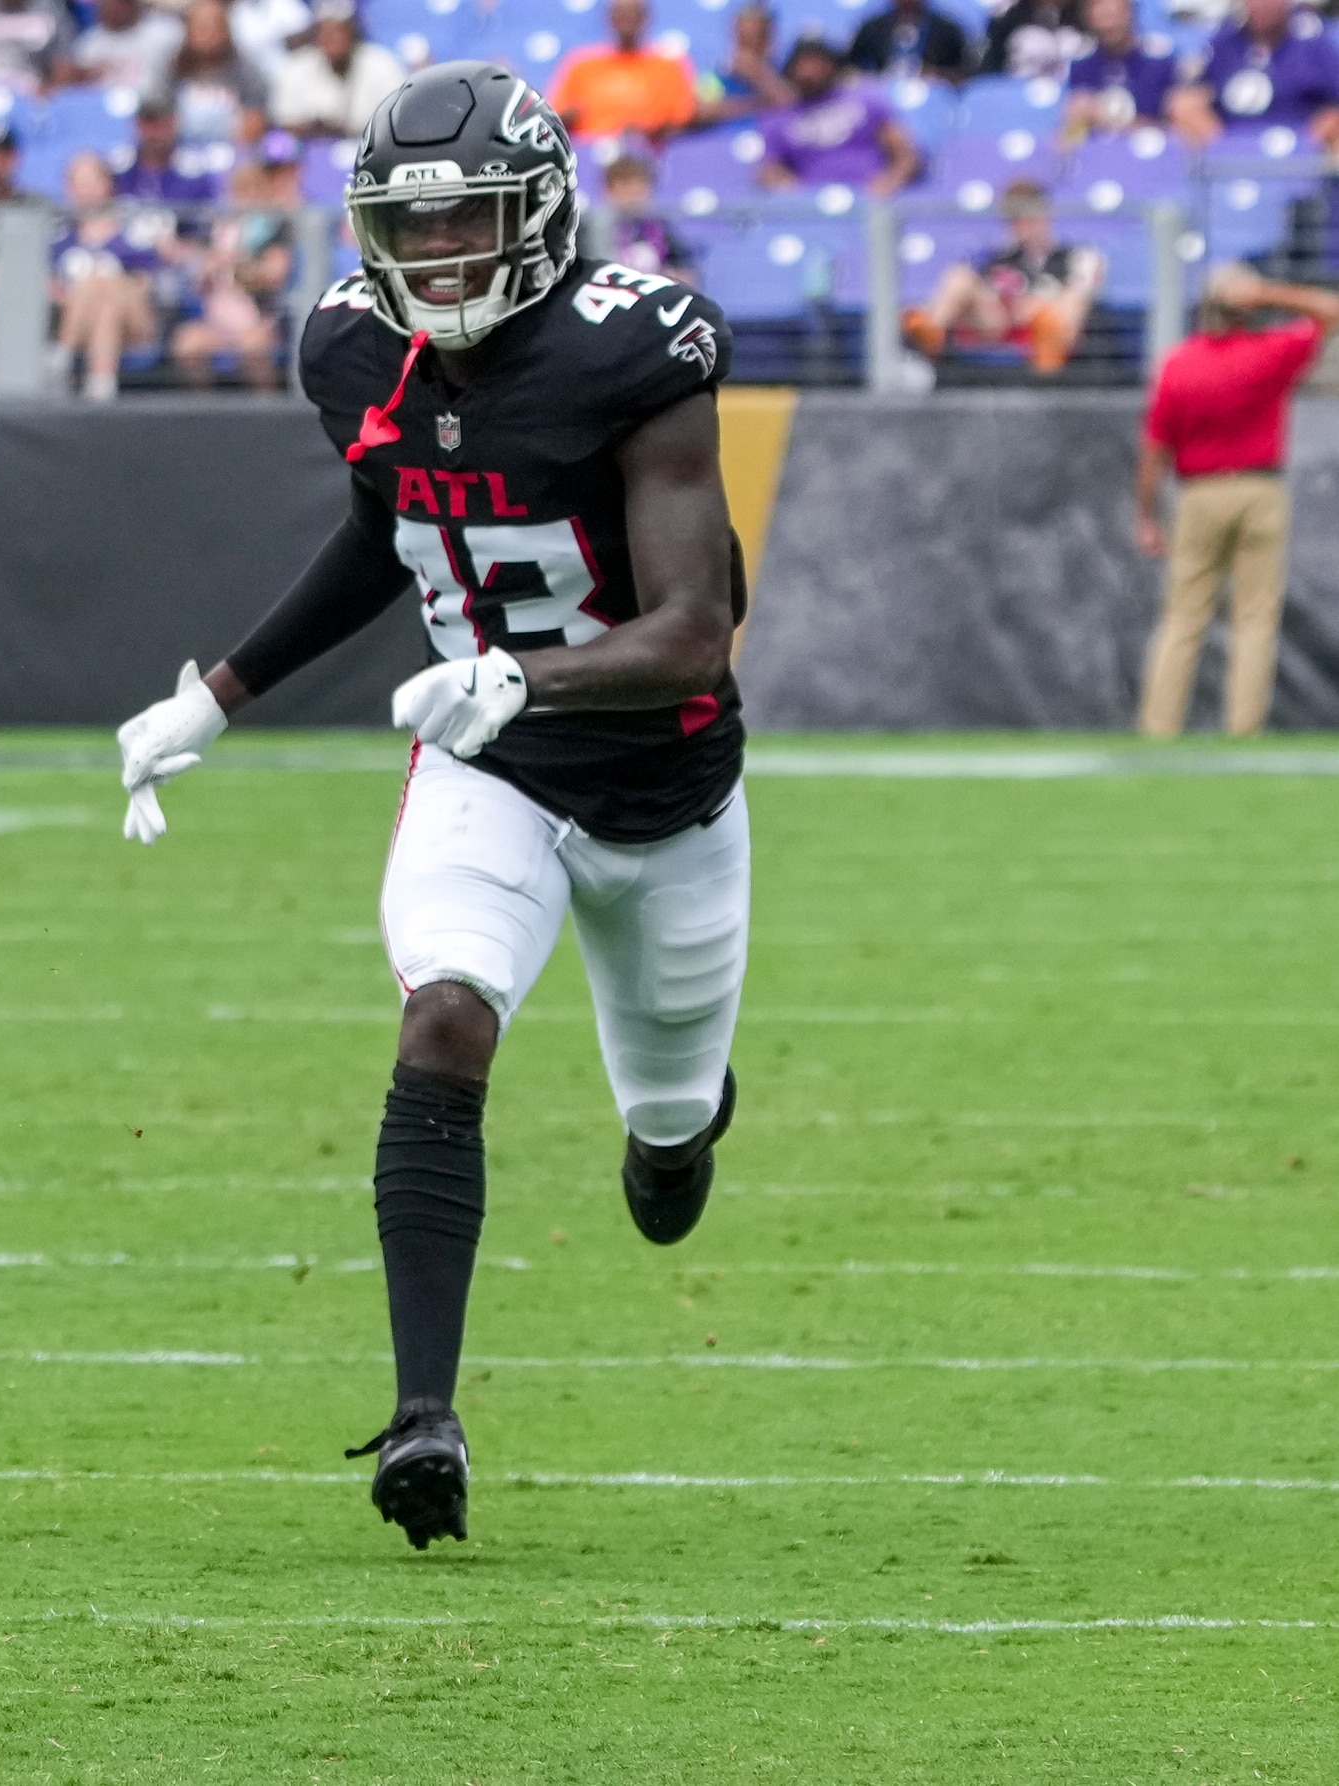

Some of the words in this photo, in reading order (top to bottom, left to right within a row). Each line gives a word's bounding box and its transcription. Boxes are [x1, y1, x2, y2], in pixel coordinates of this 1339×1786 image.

[406, 167, 441, 180] ATL
[572, 264, 674, 324] 43
[441, 429, 458, 442] NFL
[394, 467, 529, 517] ATL
